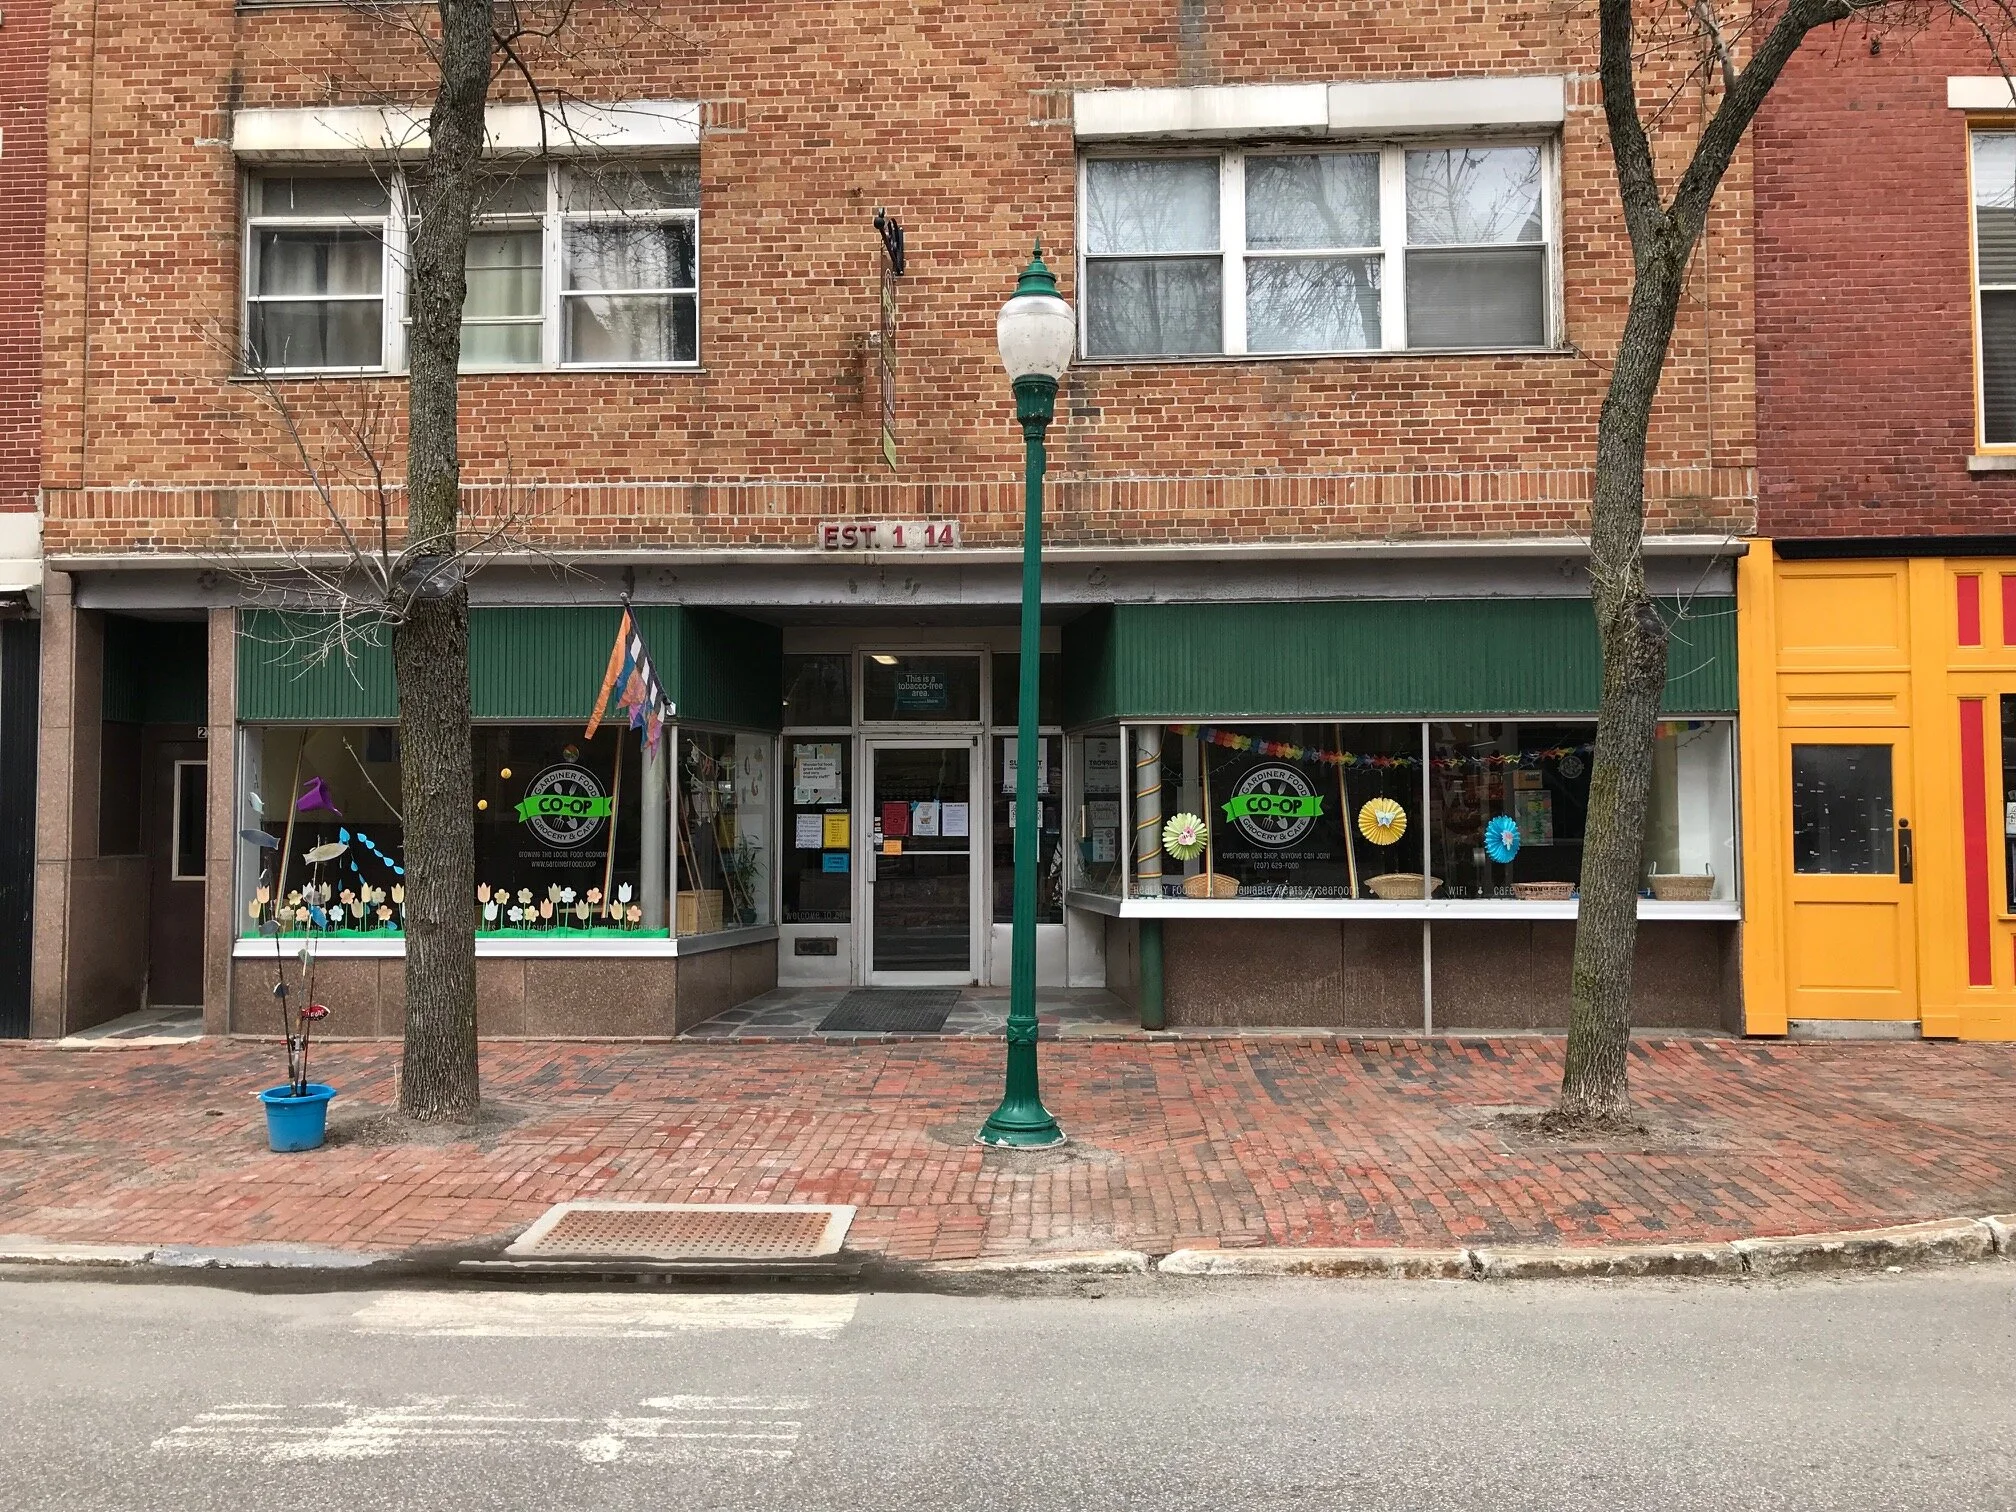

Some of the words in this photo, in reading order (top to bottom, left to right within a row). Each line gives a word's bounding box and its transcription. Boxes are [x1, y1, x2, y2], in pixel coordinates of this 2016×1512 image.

[824, 525, 880, 549] EST.
[898, 682, 943, 690] tobacco-free
[905, 675, 921, 683] This
[923, 675, 929, 683] is
[535, 771, 577, 795] GARDINER
[578, 774, 597, 797] FOOD
[1241, 770, 1286, 794] GARDINER
[1286, 774, 1308, 796] FOOD
[538, 797, 593, 815] CO-OP
[1245, 797, 1303, 814] CO-OP
[534, 818, 568, 840] GROCERY
[1242, 818, 1278, 841] GROCERY
[1253, 861, 1270, 870] (207)
[1271, 861, 1300, 869] 629-FOOD
[1448, 886, 1467, 896] WIFI
